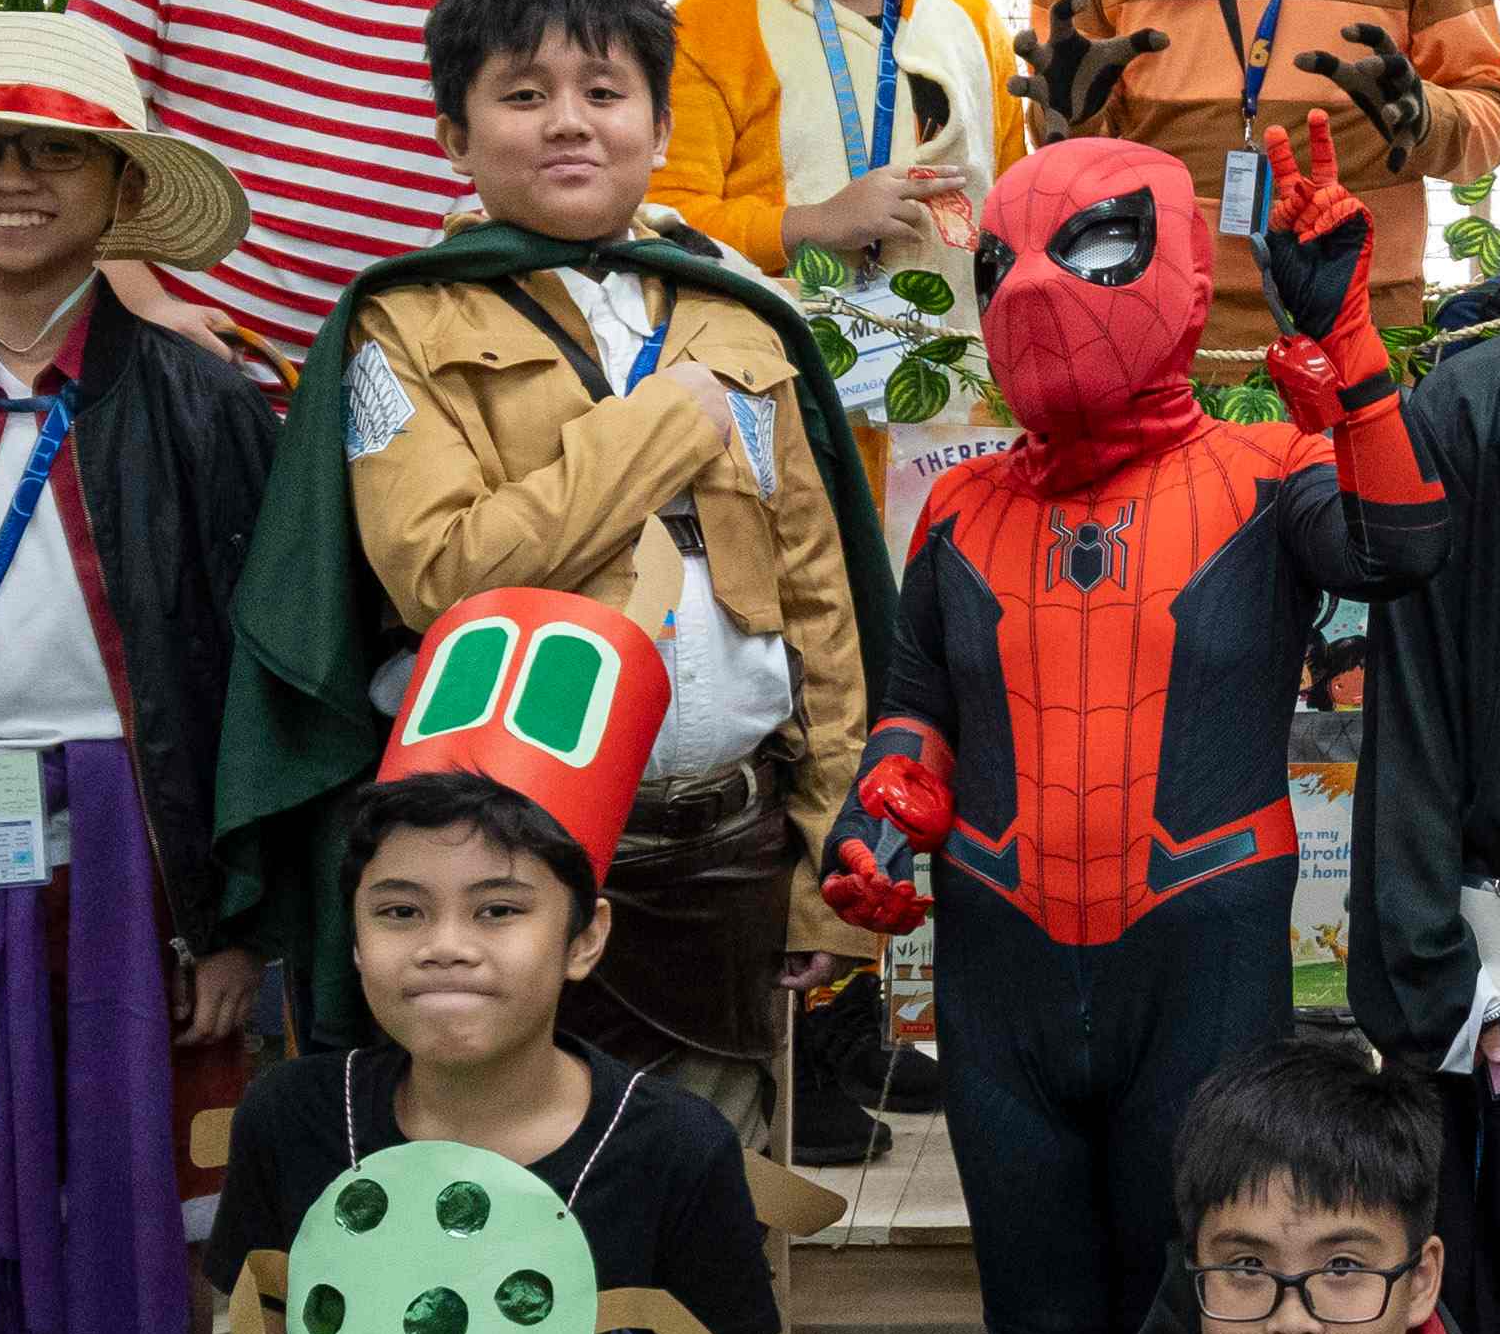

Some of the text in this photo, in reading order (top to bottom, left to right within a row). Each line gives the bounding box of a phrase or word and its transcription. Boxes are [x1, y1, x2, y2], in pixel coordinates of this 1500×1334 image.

[838, 378, 886, 399] ONZAGA
[1316, 831, 1340, 842] my
[1312, 864, 1350, 879] hom
